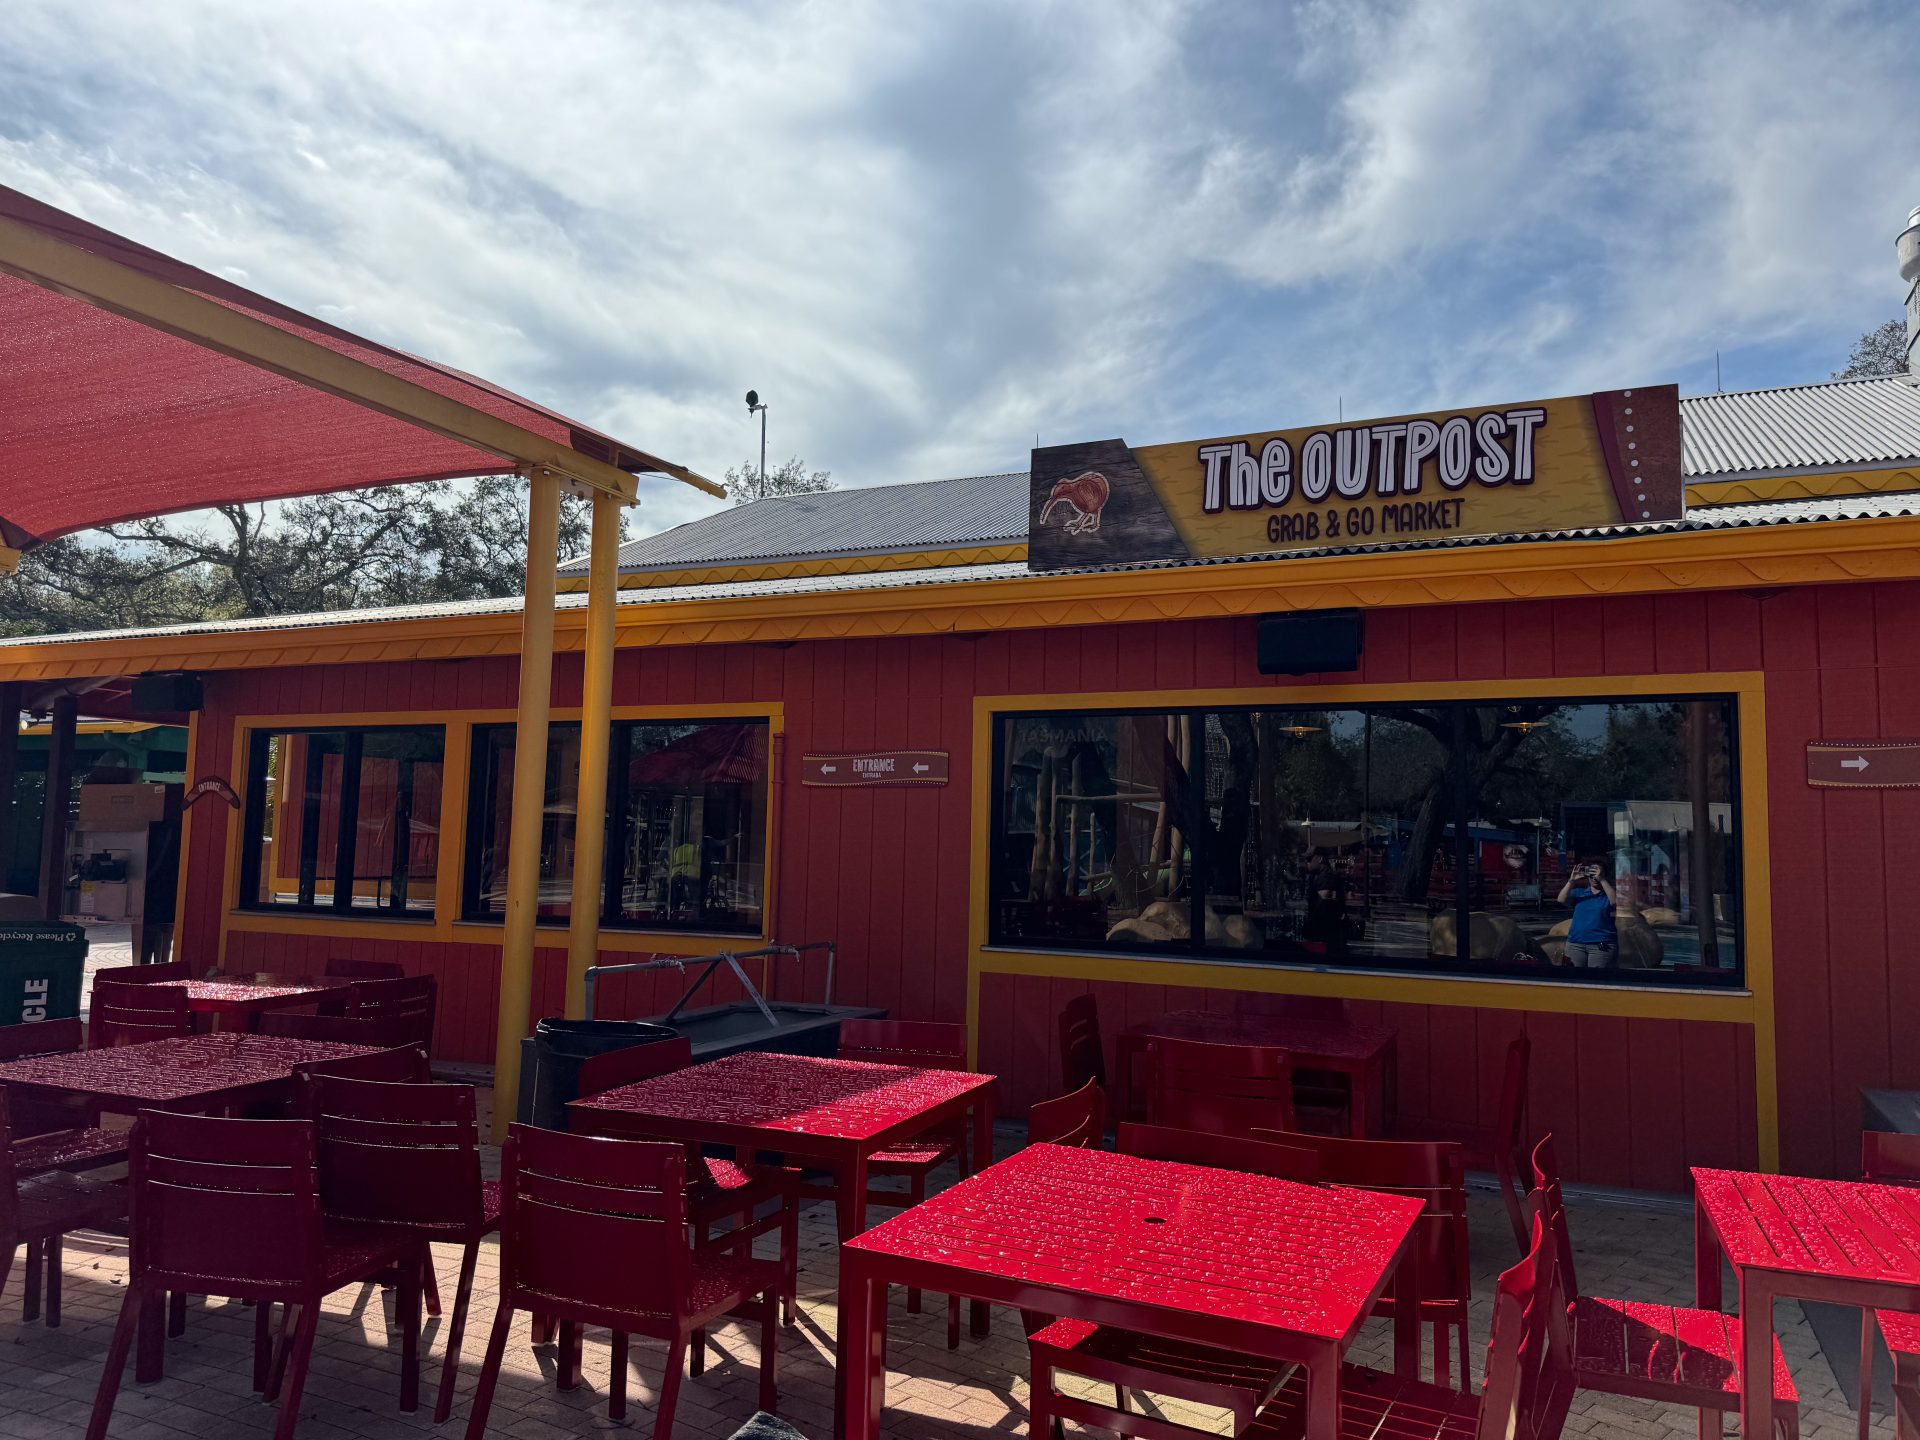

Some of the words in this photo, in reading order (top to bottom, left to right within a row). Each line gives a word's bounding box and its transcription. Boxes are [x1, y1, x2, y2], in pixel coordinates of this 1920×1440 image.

[1199, 438, 1293, 513] The
[1301, 408, 1546, 502] OUTPOST
[1267, 511, 1320, 543] GRAB
[1326, 509, 1340, 538] &
[1346, 506, 1375, 537] GO
[1381, 498, 1466, 533] MARKET
[1020, 725, 1108, 743] TASMANIA
[853, 758, 895, 772] ENTRANCE
[198, 781, 221, 793] ENTRANCE
[35, 933, 65, 943] Please
[22, 978, 49, 1023] CLE
